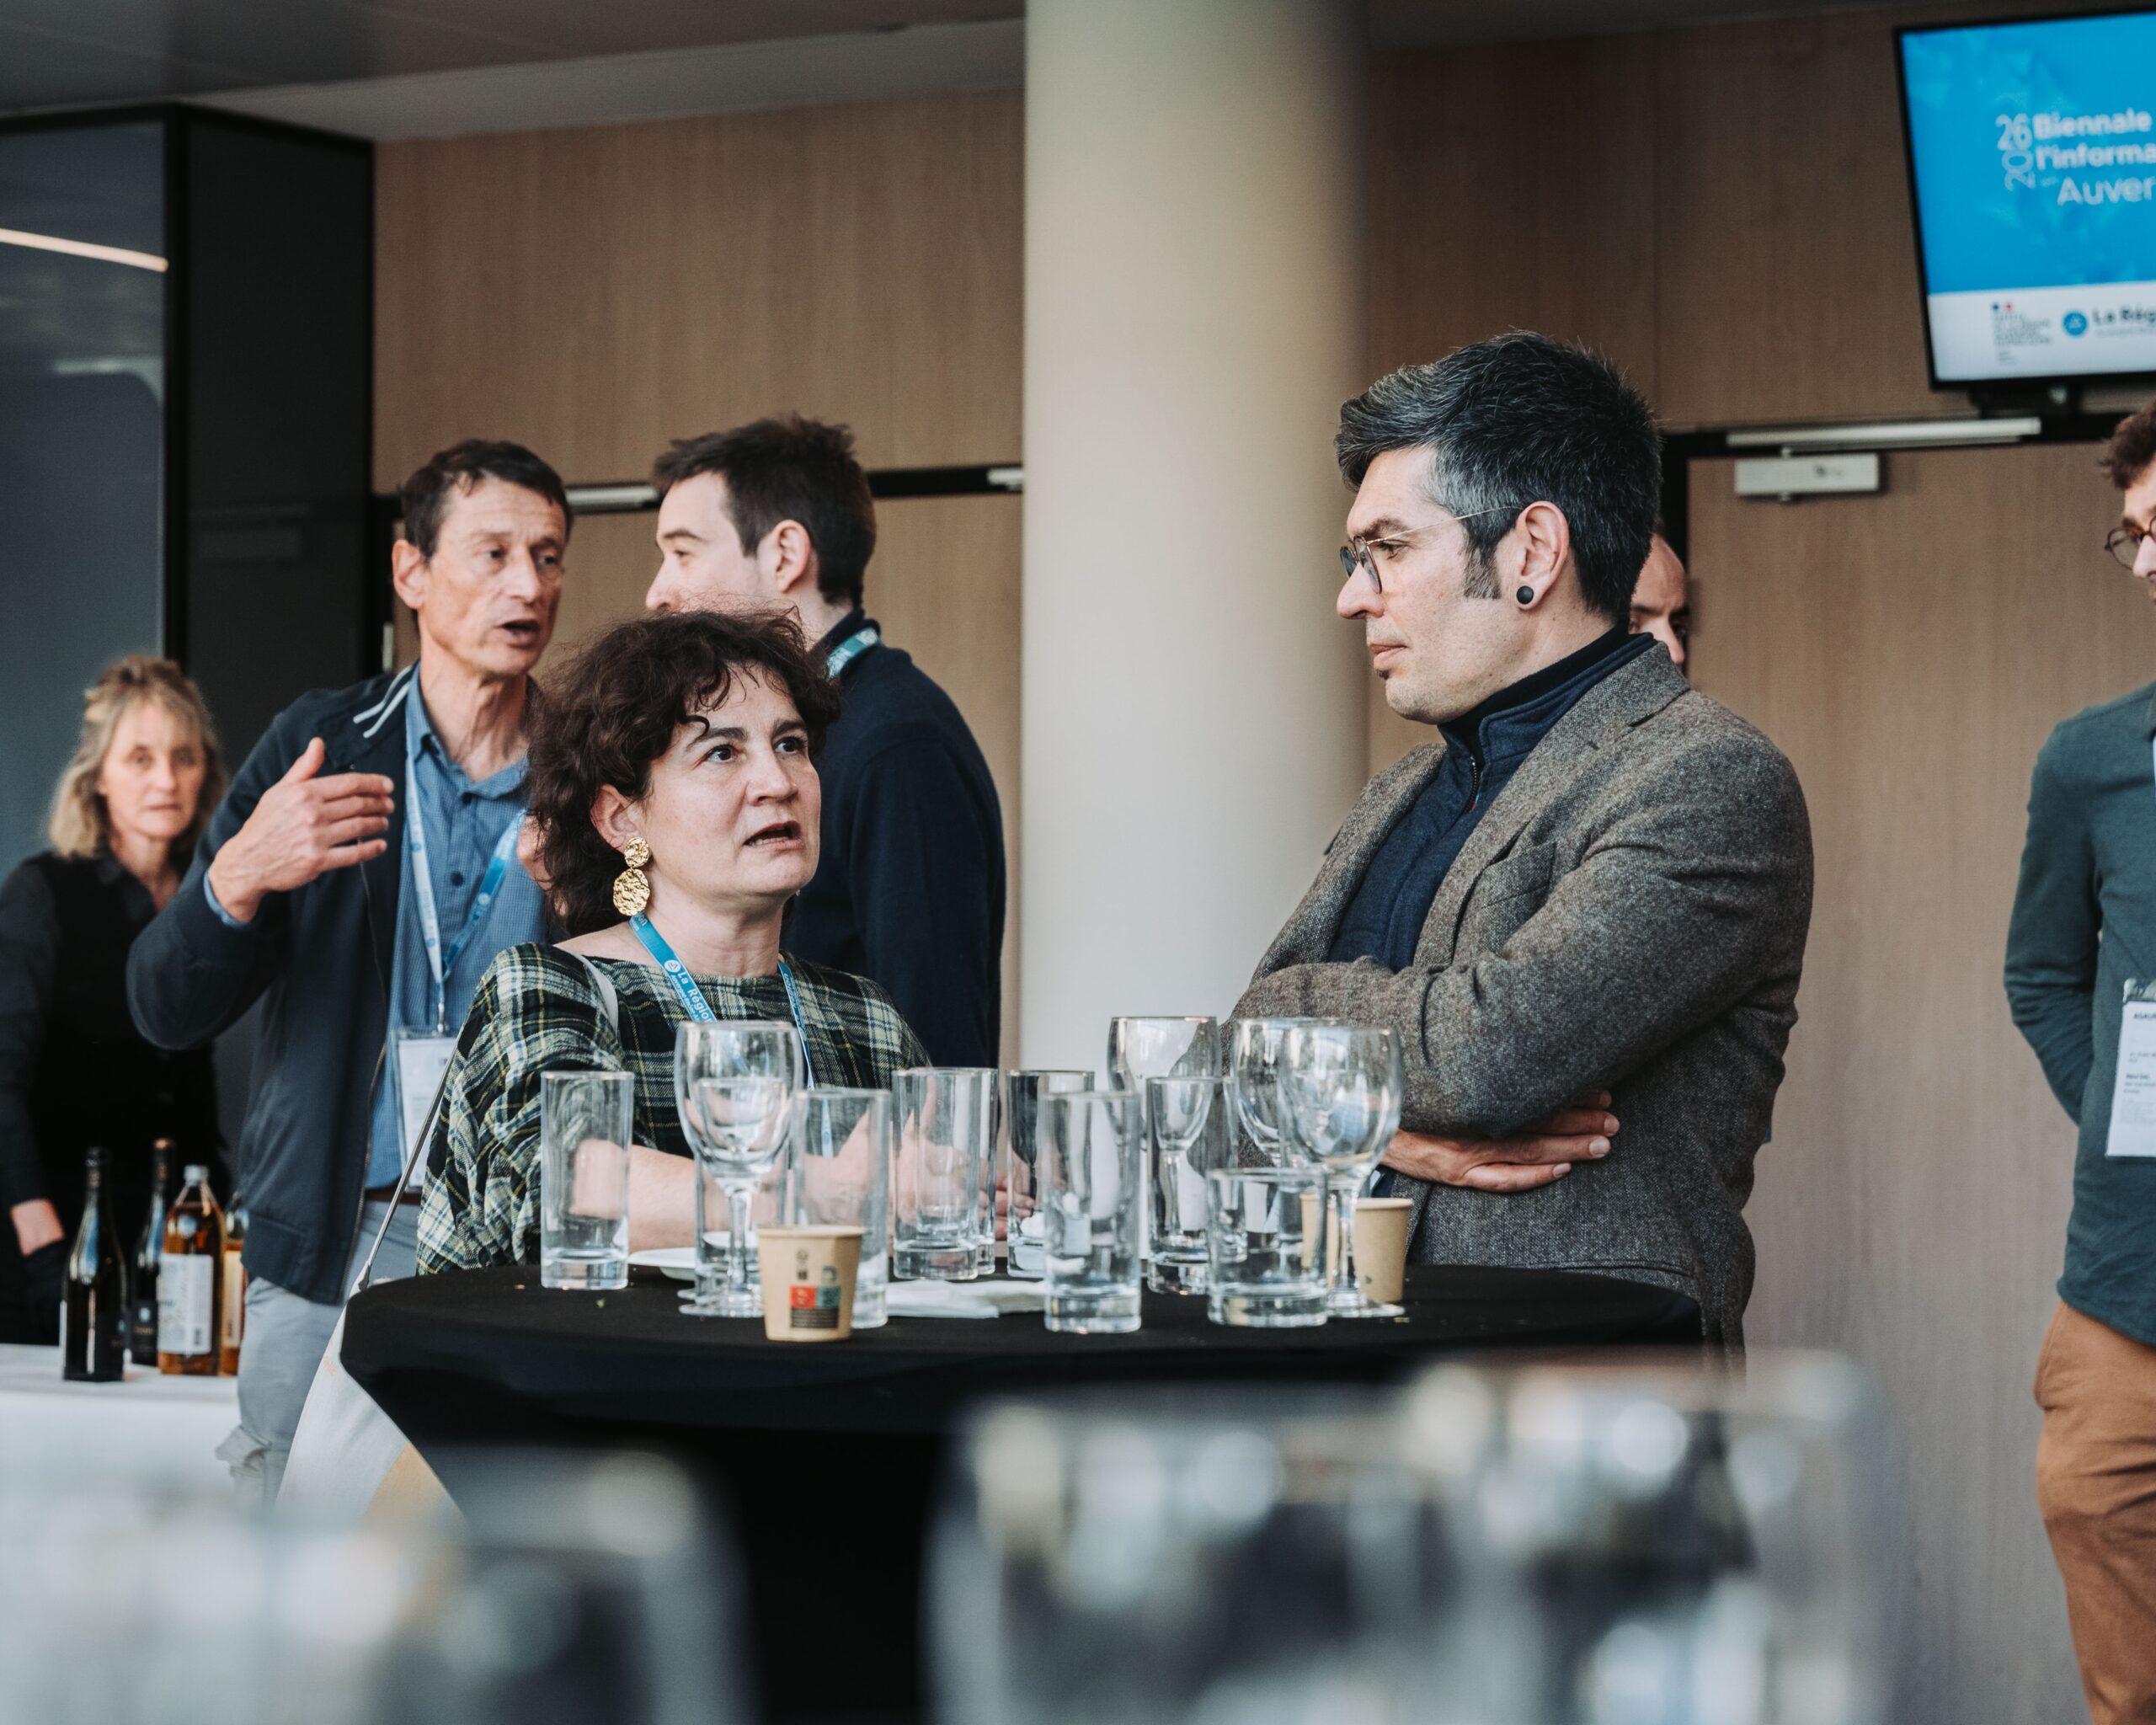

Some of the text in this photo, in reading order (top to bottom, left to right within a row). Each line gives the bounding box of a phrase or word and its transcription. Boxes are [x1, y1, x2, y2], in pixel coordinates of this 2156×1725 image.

[1995, 113, 2033, 151] 26
[2033, 108, 2153, 140] Biennale
[2036, 142, 2156, 170] l'informa
[2057, 176, 2156, 206] Auver
[678, 972, 689, 984] La
